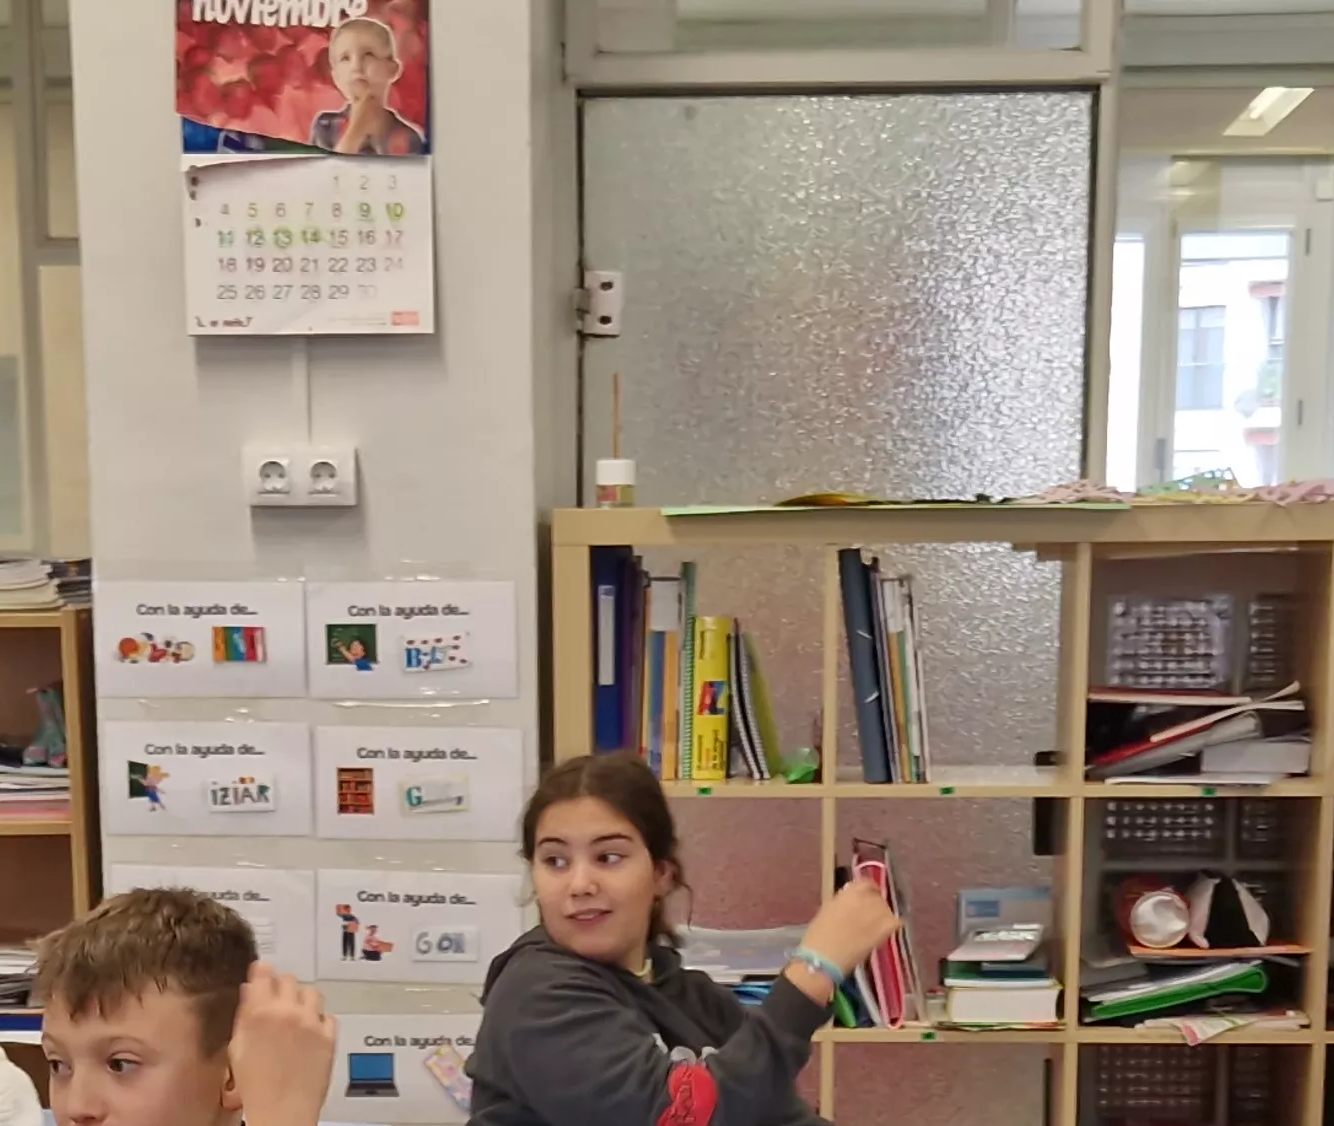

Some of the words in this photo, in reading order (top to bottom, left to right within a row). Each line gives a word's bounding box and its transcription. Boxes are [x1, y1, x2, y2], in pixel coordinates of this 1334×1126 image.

[333, 175, 340, 191] 1
[359, 175, 369, 190] 2
[388, 175, 397, 190] 3
[220, 203, 230, 215] 4
[247, 203, 258, 218] 5
[275, 203, 286, 217] 6
[305, 203, 314, 217] 7
[331, 203, 343, 218] 8
[359, 203, 371, 218] 9
[386, 203, 405, 218] 10
[217, 230, 234, 246] 11
[245, 230, 265, 247] 12
[272, 230, 293, 247] 13
[301, 229, 322, 243] 14
[330, 230, 349, 246] 15
[357, 230, 377, 246] 16
[385, 230, 404, 245] 17
[217, 257, 237, 272] 18
[245, 257, 266, 272] 19
[272, 257, 293, 272] 20
[300, 258, 319, 272] 21
[328, 257, 349, 272] 22
[356, 257, 377, 272] 23
[383, 257, 404, 271] 24
[217, 284, 238, 300] 25
[245, 284, 265, 300] 26
[272, 284, 294, 300] 27
[300, 284, 322, 300] 28
[328, 284, 350, 299] 29
[135, 603, 165, 616] Con
[167, 603, 180, 616] la
[183, 603, 227, 619] ayuda
[347, 605, 376, 617] Con
[378, 605, 392, 617] la
[394, 604, 439, 620] ayuda
[144, 743, 173, 756] Con
[175, 743, 188, 756] la
[190, 743, 235, 759] ayuda
[356, 747, 385, 759] Con
[387, 748, 400, 759] la
[403, 748, 447, 763] ayuda
[357, 890, 385, 903] Con
[387, 891, 400, 903] la
[402, 892, 446, 907] ayuda
[364, 1035, 392, 1047] Con
[394, 1034, 407, 1047] la
[410, 1034, 452, 1049] ayuda
